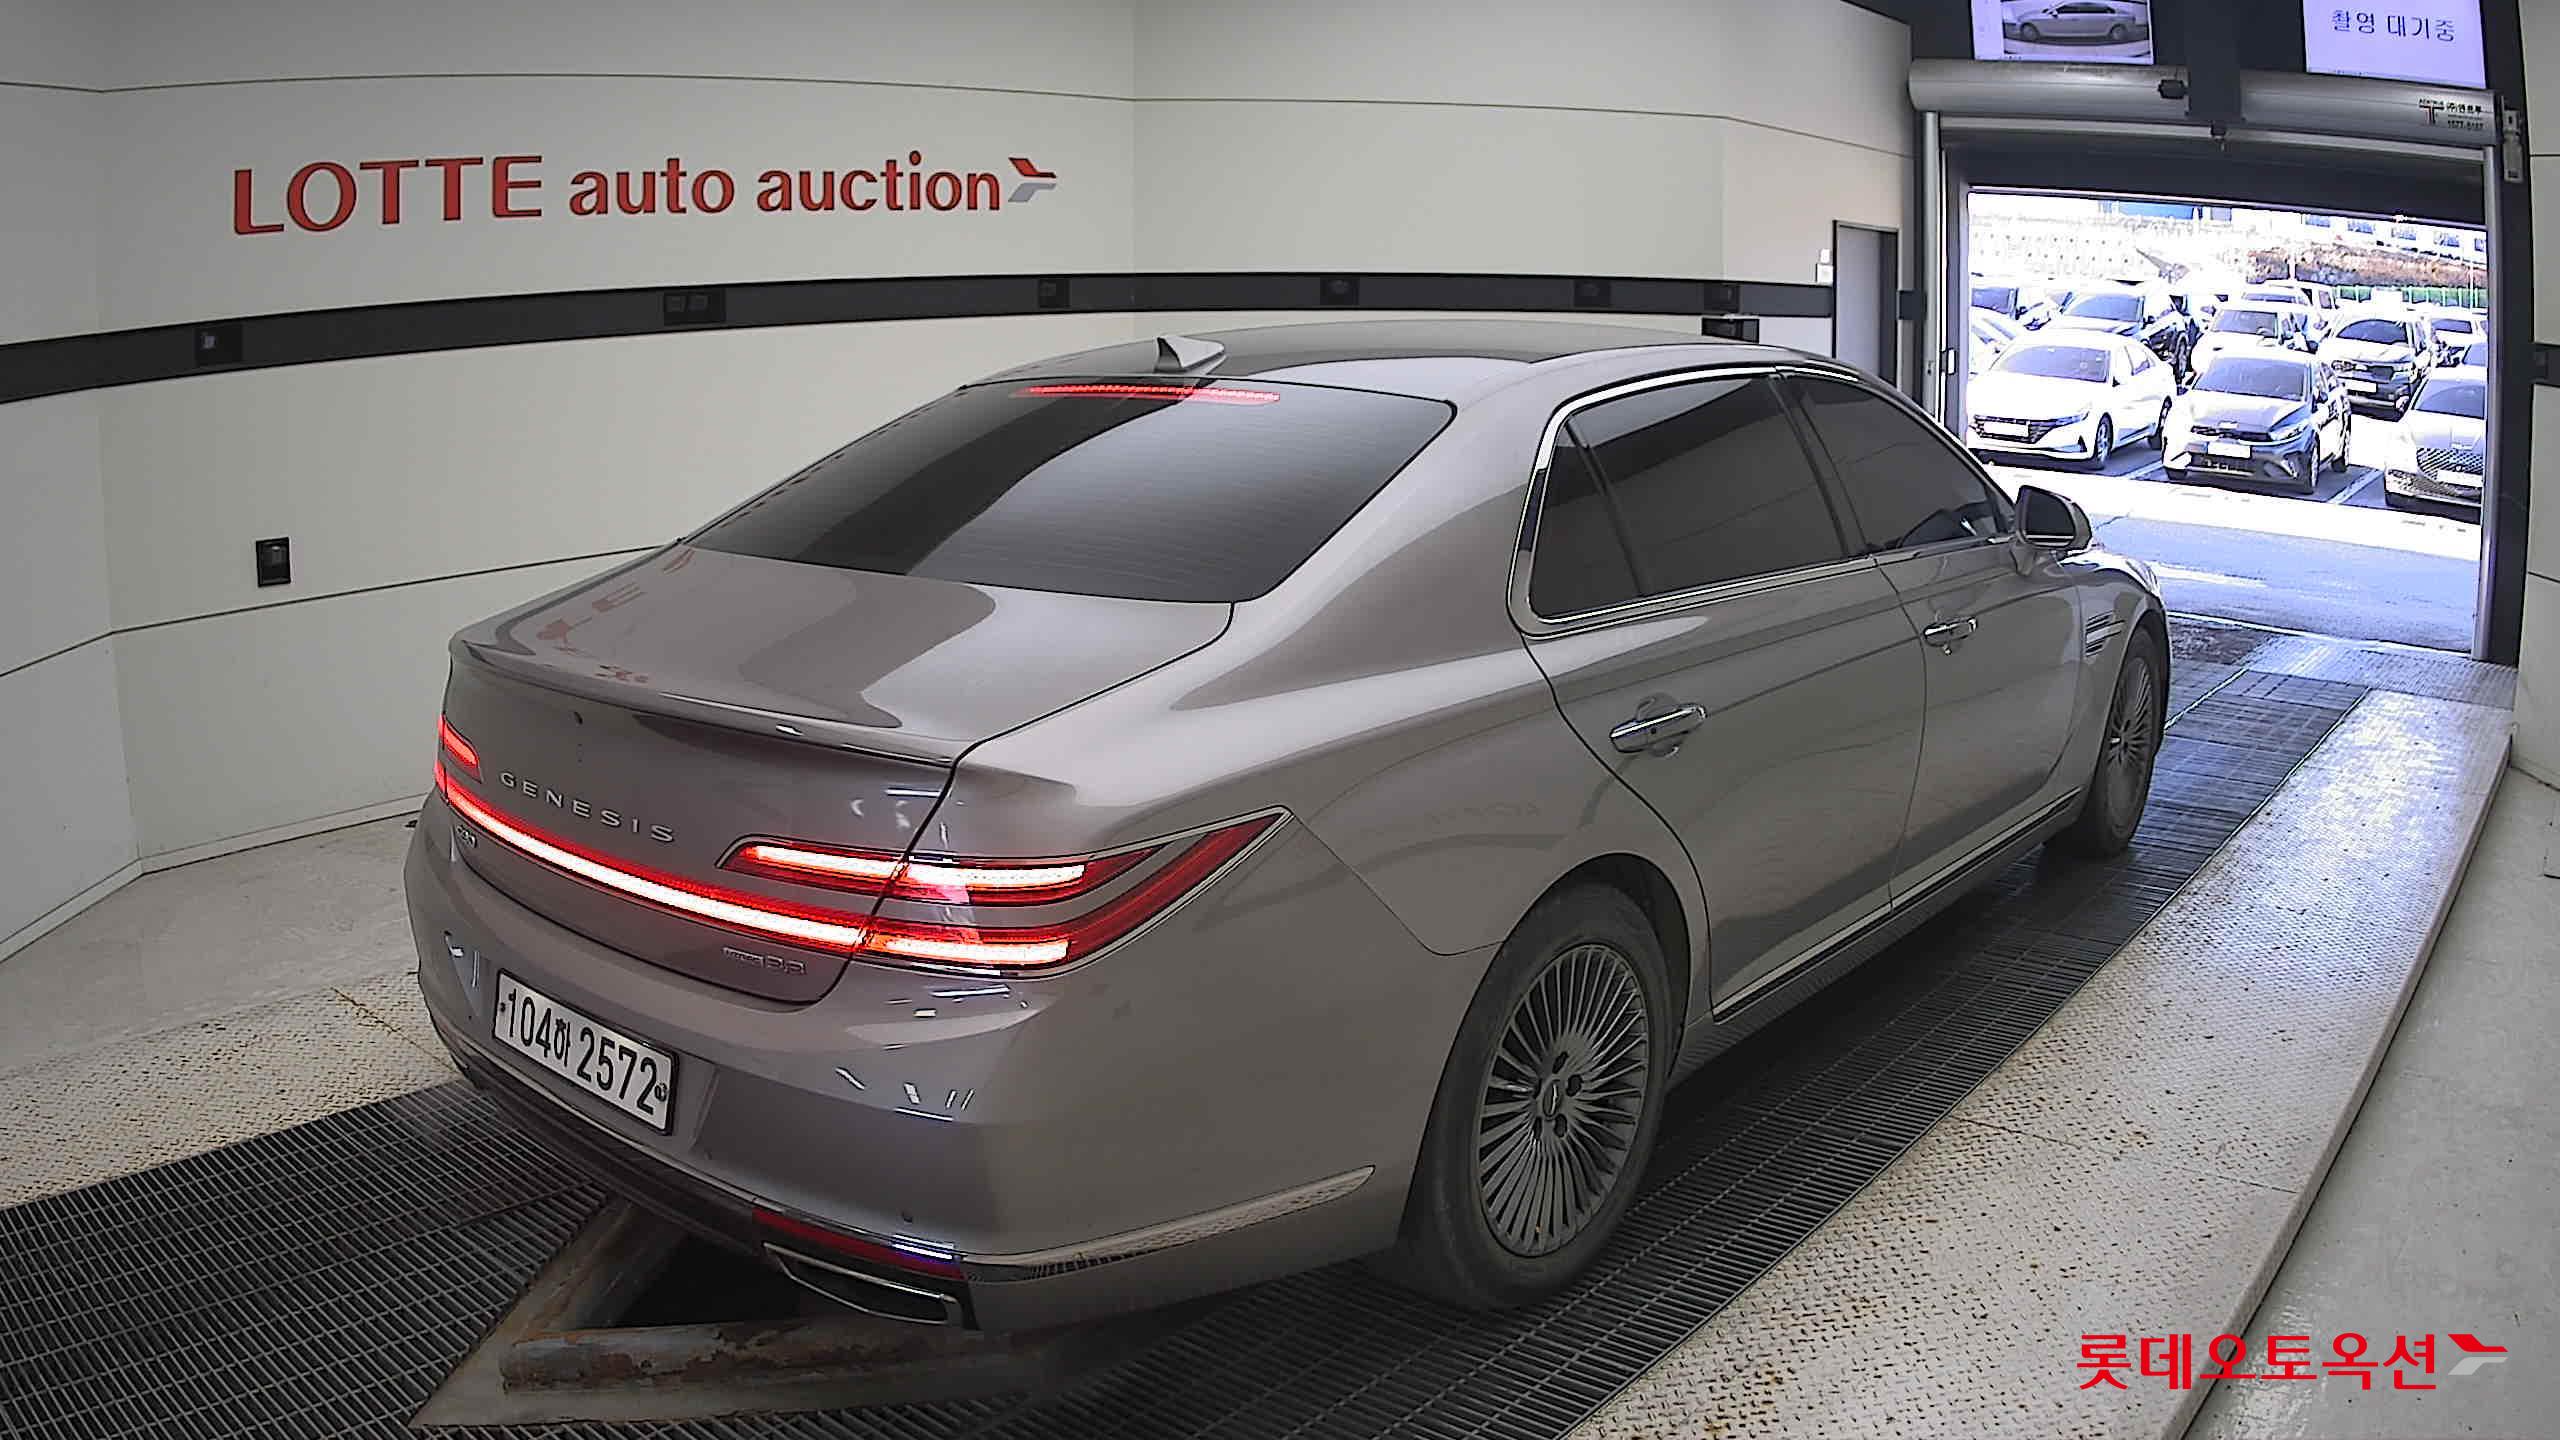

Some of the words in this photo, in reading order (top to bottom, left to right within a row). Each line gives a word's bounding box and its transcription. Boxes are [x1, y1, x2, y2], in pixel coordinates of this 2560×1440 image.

[2332, 9, 2376, 34] 촬영
[234, 155, 543, 235] LOTTE
[568, 157, 735, 216] auto
[756, 149, 1001, 212] auction
[499, 771, 674, 843] GENESIS
[508, 988, 571, 1068] 104하
[576, 1026, 658, 1116] 2572
